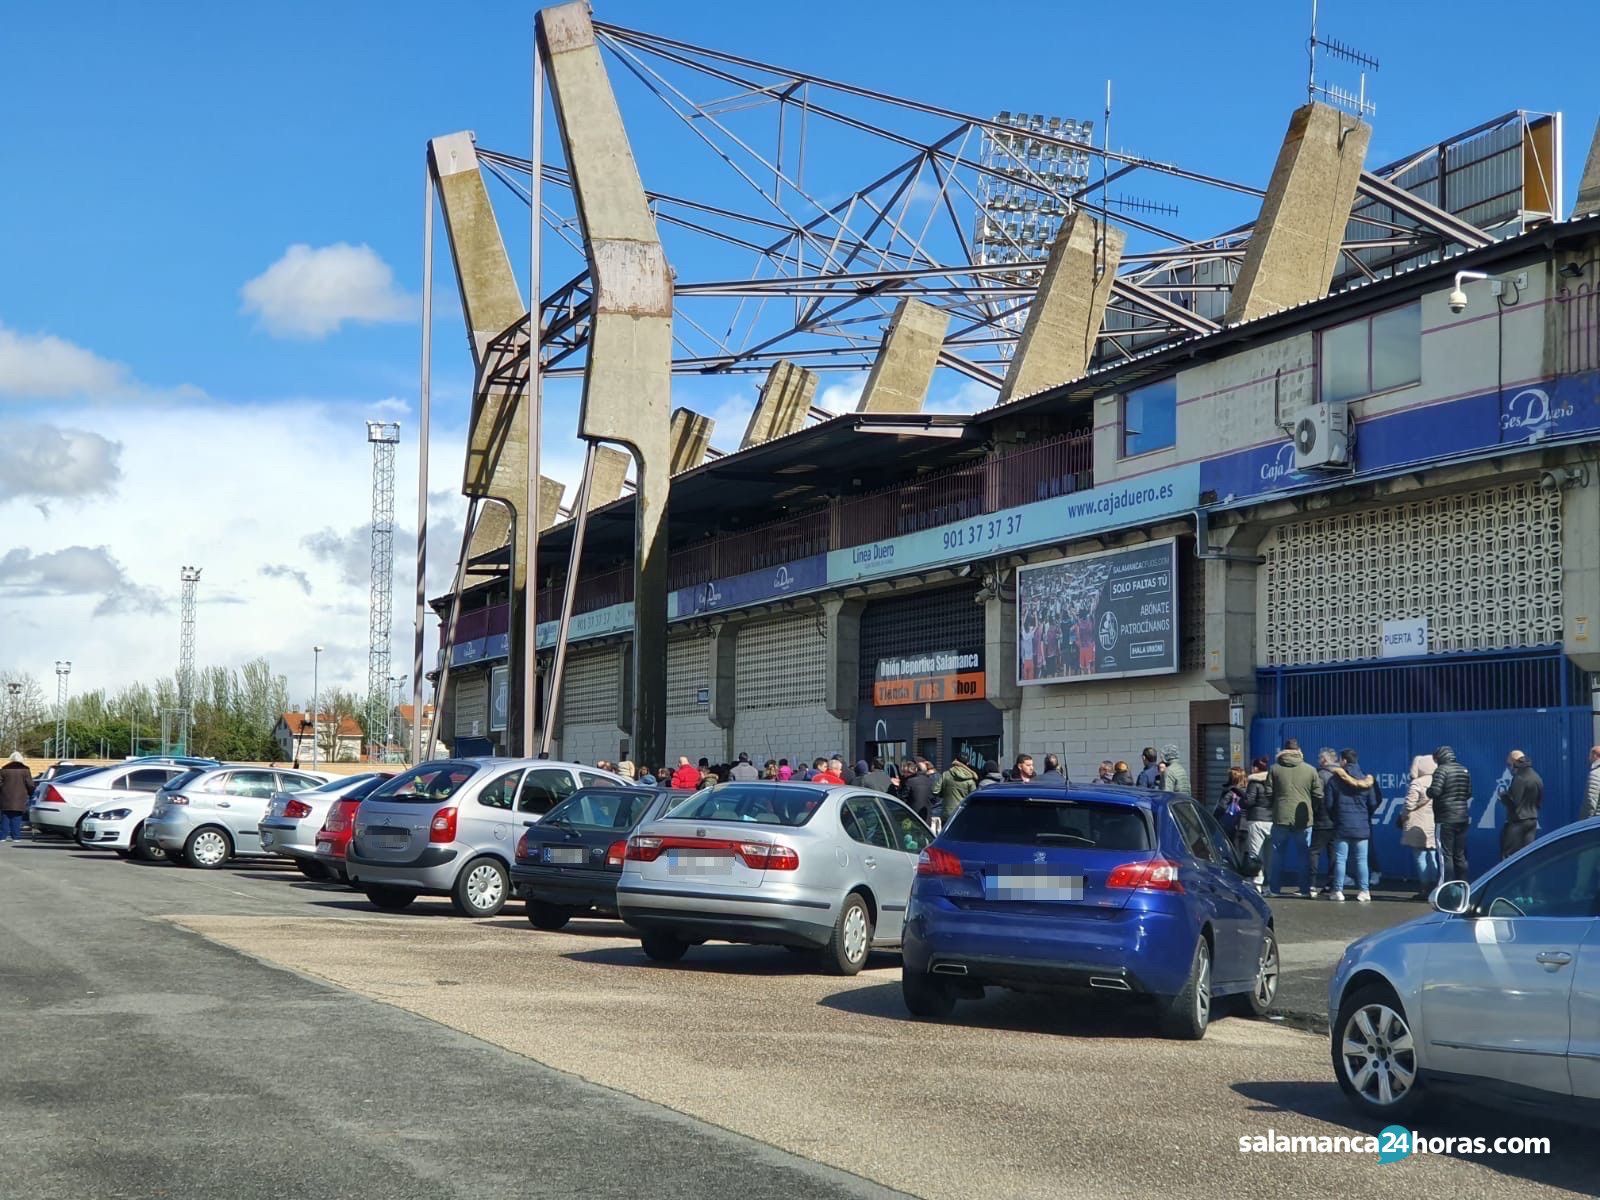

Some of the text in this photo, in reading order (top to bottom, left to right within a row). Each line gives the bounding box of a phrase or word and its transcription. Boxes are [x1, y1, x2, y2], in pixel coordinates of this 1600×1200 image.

[1068, 484, 1174, 519] www.cajaduero.es
[943, 514, 1023, 550] 901 37 37 37
[873, 543, 895, 561] Duero
[1112, 574, 1168, 595] SOLO FALTAS TÚ
[1140, 602, 1170, 616] ABÓNATE
[1120, 620, 1170, 635] PATROCÍNANOS
[1384, 627, 1425, 646] PUERTA 3
[880, 653, 979, 677] Unión Deportiva Salamanca
